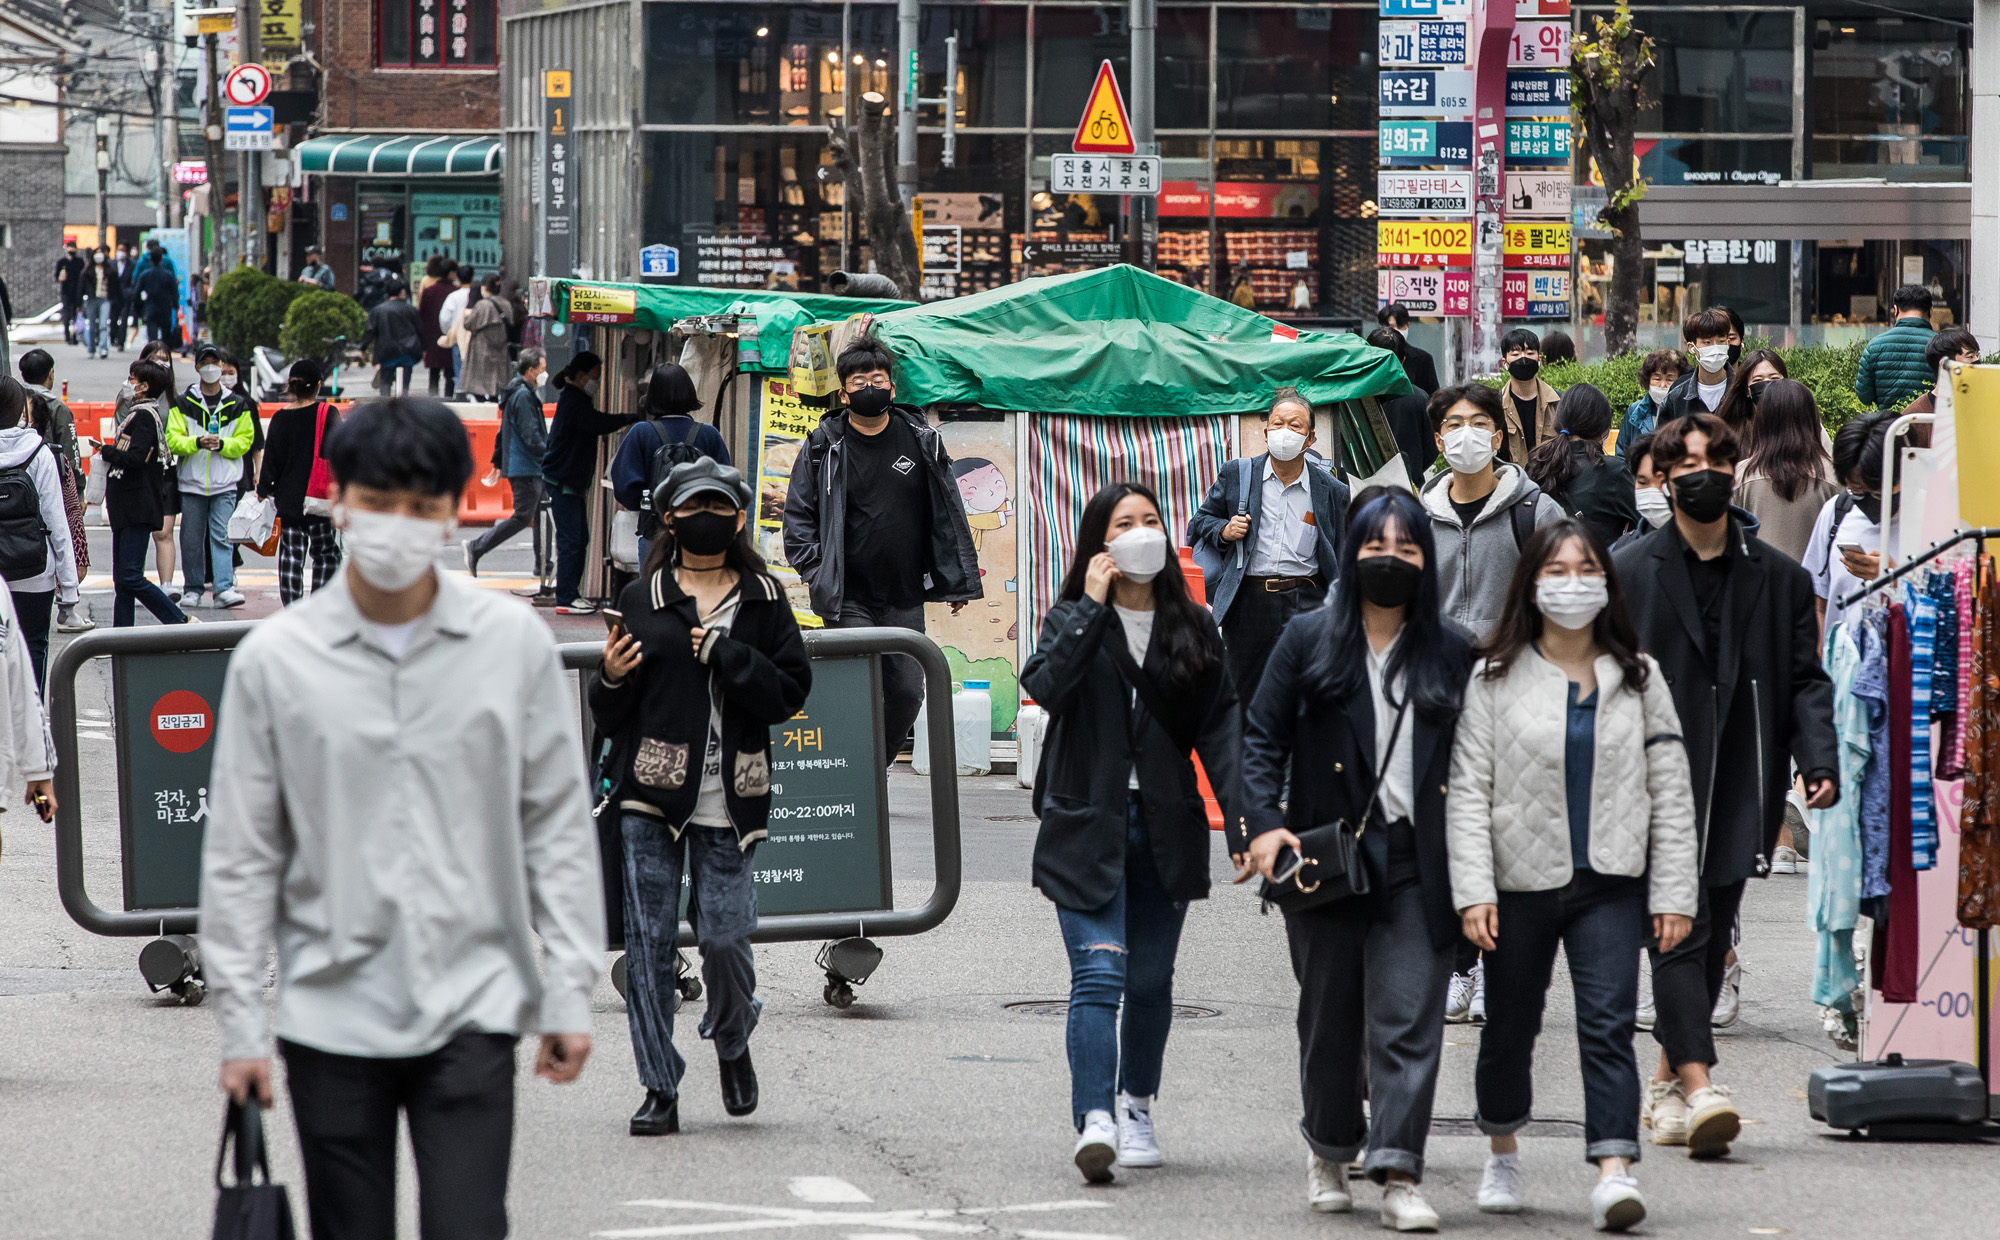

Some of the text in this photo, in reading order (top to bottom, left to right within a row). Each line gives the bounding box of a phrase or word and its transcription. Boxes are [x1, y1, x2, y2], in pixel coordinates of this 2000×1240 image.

[1381, 35, 1413, 61] 안과
[1539, 26, 1561, 63] 약
[1420, 51, 1465, 61] 322-8275
[1383, 78, 1429, 101] 박수갑
[1441, 97, 1467, 107] 605호
[553, 108, 563, 126] 1
[1440, 147, 1468, 159] 612호
[1510, 141, 1550, 154] 법무상담
[551, 143, 566, 209] 홍대입구
[1063, 175, 1150, 189] 자전거 주의
[1388, 179, 1464, 195] 기구필라테스
[1431, 198, 1464, 209] 2010호
[1384, 228, 1467, 248] 3141-1002
[1505, 229, 1526, 247] 1층
[1684, 240, 1752, 264] 달콤한
[649, 259, 669, 272] 153
[1523, 255, 1557, 265] 오피스텔
[1410, 277, 1438, 296] 직방
[1446, 280, 1470, 293] 지하
[1505, 280, 1526, 293] 지하
[574, 289, 600, 299] 닭꼬치
[1449, 297, 1469, 310] 1층
[1507, 297, 1526, 311] 1층
[161, 715, 202, 729] 진입금지
[783, 727, 822, 752] 거리
[797, 758, 849, 771] 행복해집니다.
[154, 789, 191, 809] 걷자,
[157, 807, 190, 825] 마포
